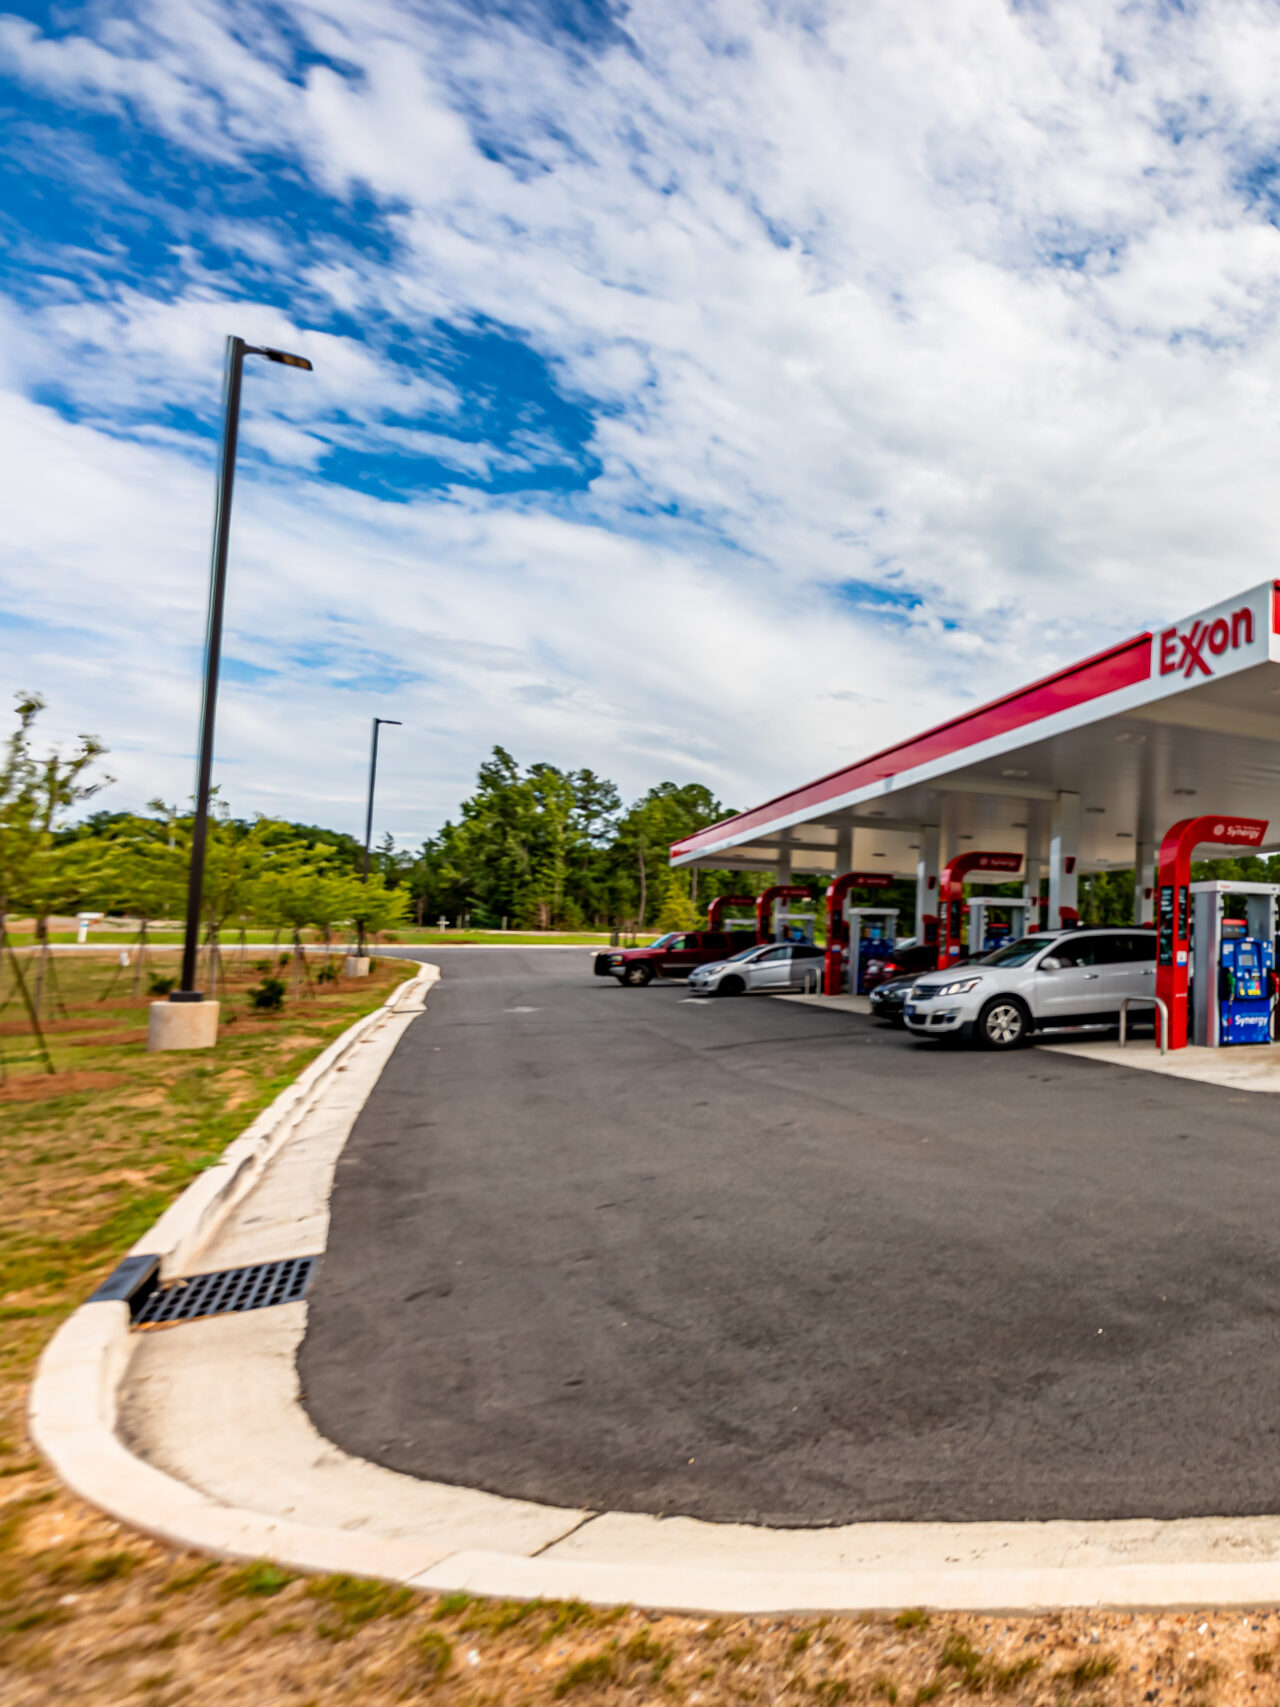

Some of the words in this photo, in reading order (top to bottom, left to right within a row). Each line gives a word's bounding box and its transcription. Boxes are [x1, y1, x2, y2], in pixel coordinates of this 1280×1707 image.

[1159, 606, 1253, 677] Exxon
[1226, 825, 1260, 839] Synergy
[1235, 1014, 1268, 1027] Synergy
